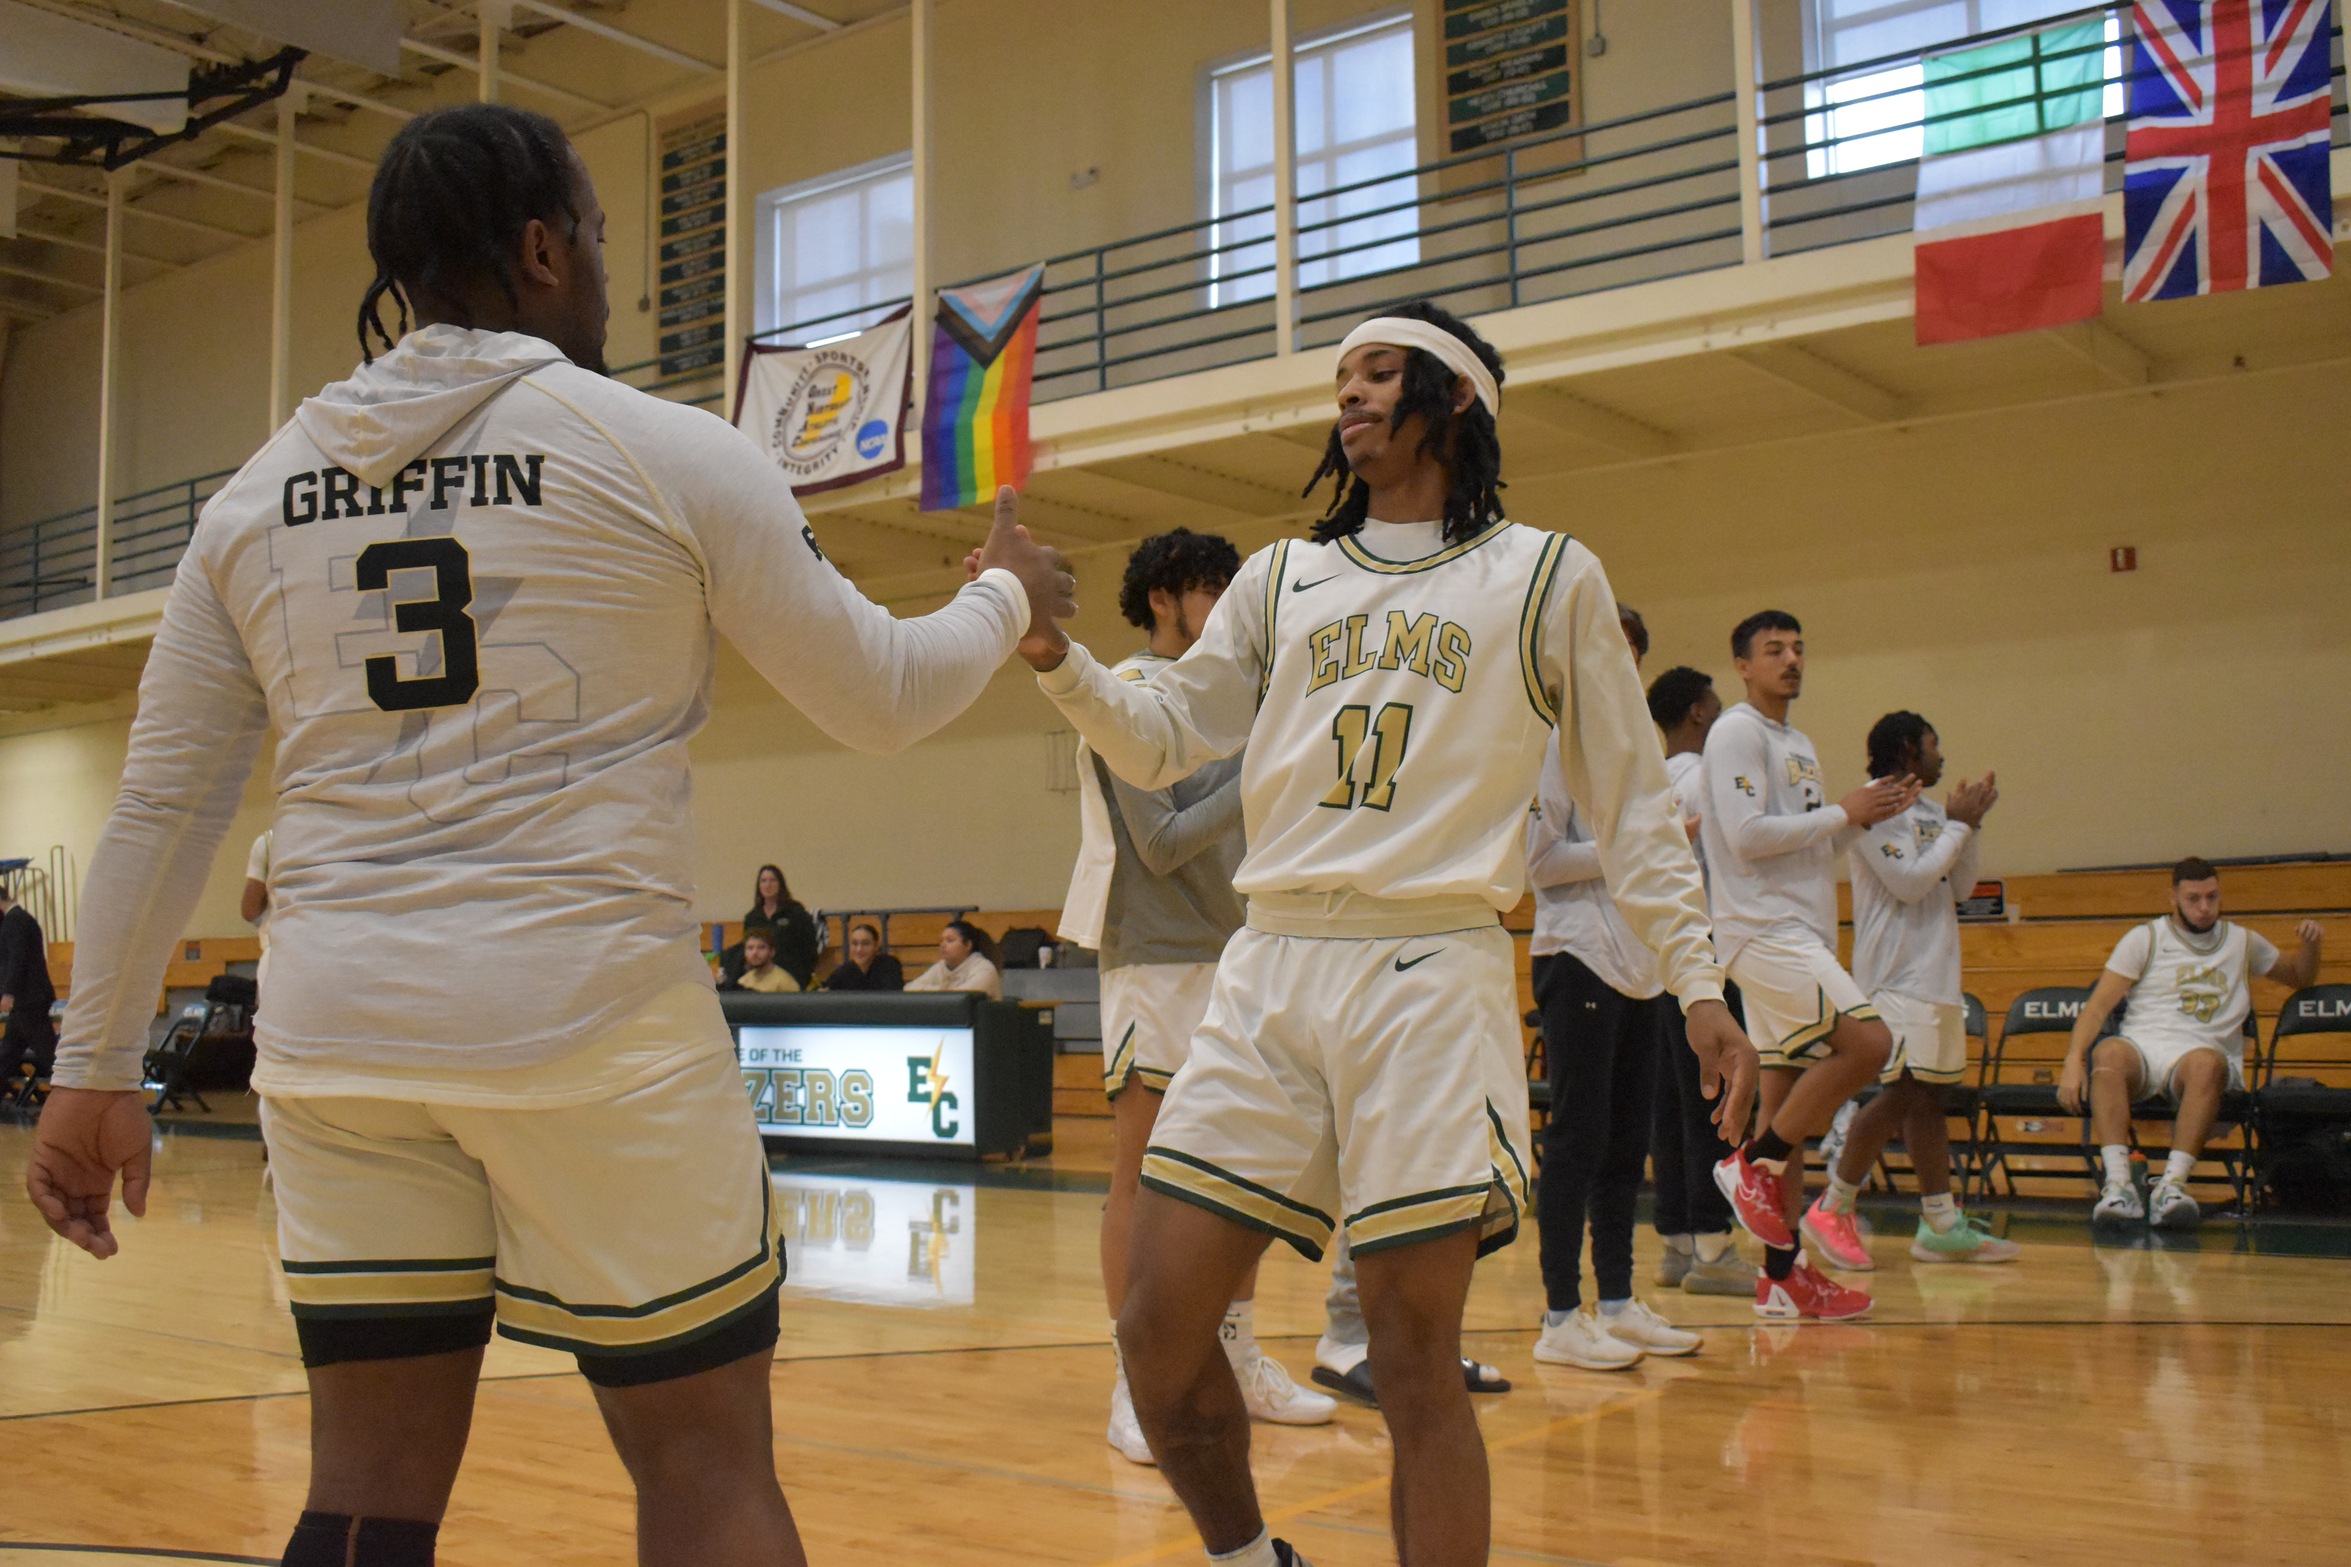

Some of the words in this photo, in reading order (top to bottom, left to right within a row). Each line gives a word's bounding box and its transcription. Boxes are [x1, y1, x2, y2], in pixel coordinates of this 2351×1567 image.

[283, 454, 546, 528] GRIFFIN
[777, 446, 839, 475] INTEGRITY
[355, 534, 481, 713] 3
[1305, 609, 1473, 699] ELMS
[1317, 702, 1414, 812] 11
[2299, 1000, 2351, 1017] ELM
[750, 1048, 768, 1062] OF
[772, 1048, 803, 1062] THE
[741, 1067, 874, 1128] ZERS
